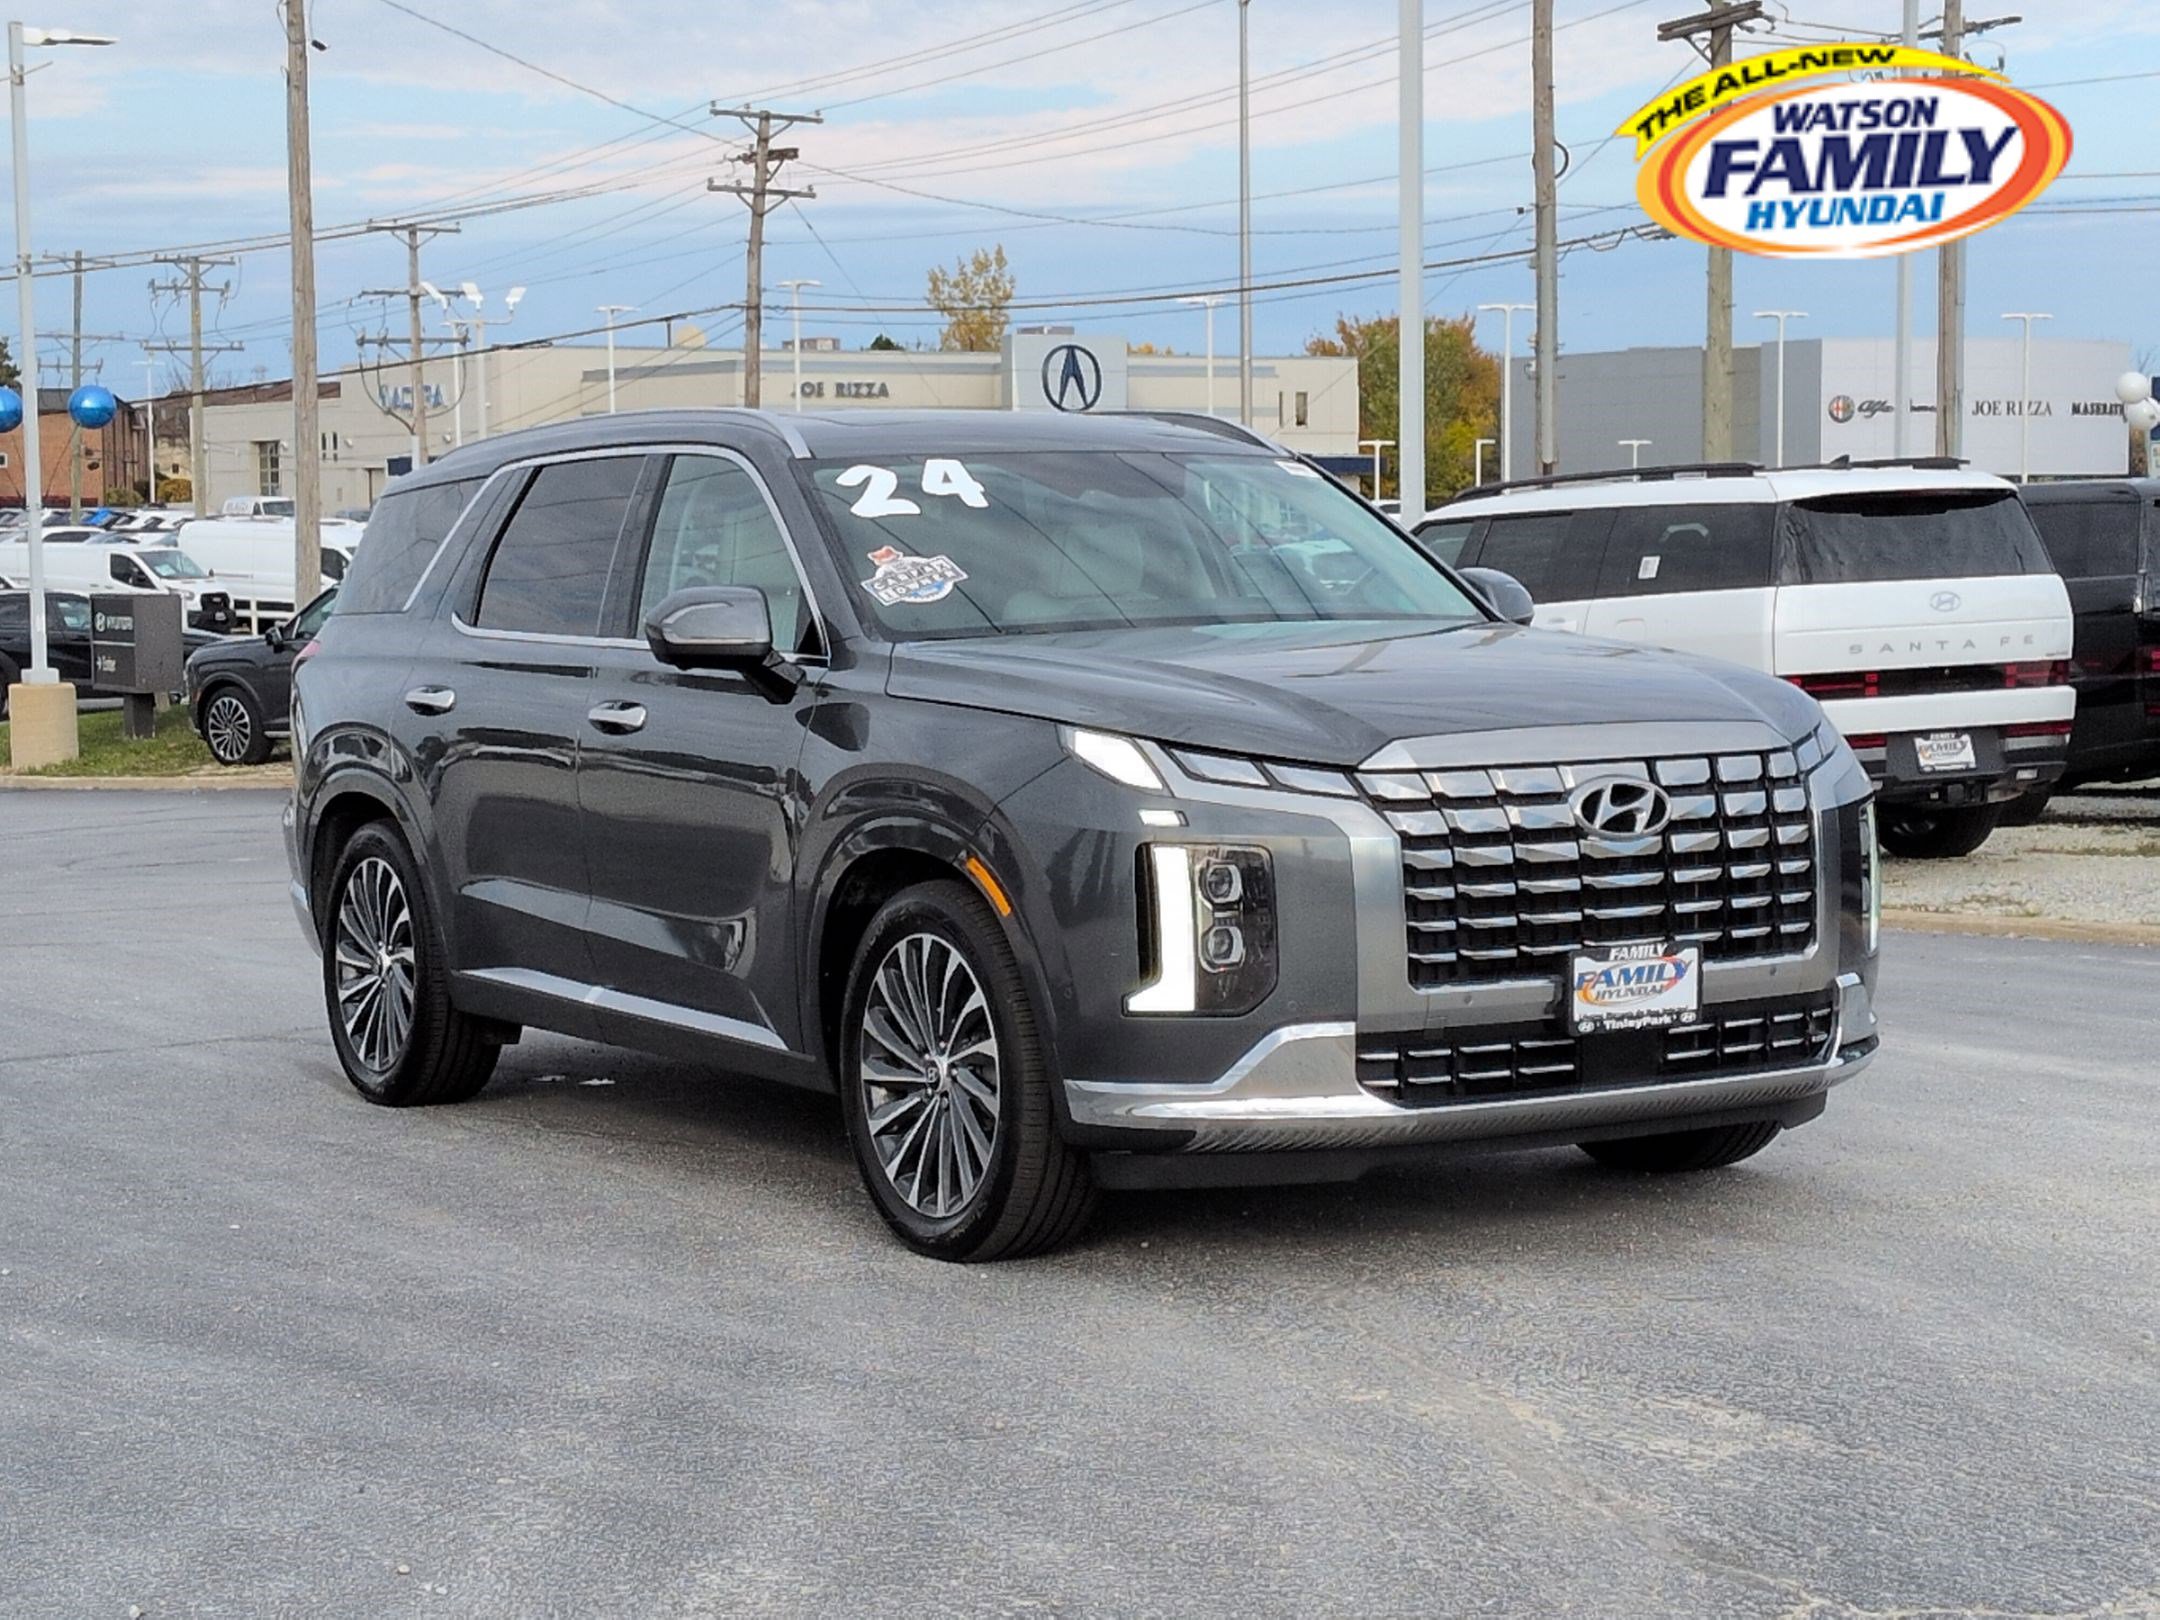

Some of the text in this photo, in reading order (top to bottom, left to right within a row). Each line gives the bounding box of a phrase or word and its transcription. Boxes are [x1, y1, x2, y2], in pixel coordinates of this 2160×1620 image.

[835, 382, 890, 398] RIZZA
[1972, 400, 2001, 416] JOE
[2006, 400, 2052, 416] RIZZA
[1849, 634, 2034, 655] SANTA FE
[1609, 943, 1668, 961] FAMILY
[1575, 960, 1693, 990] FAMILY
[1596, 984, 1665, 1000] HYUNDAI
